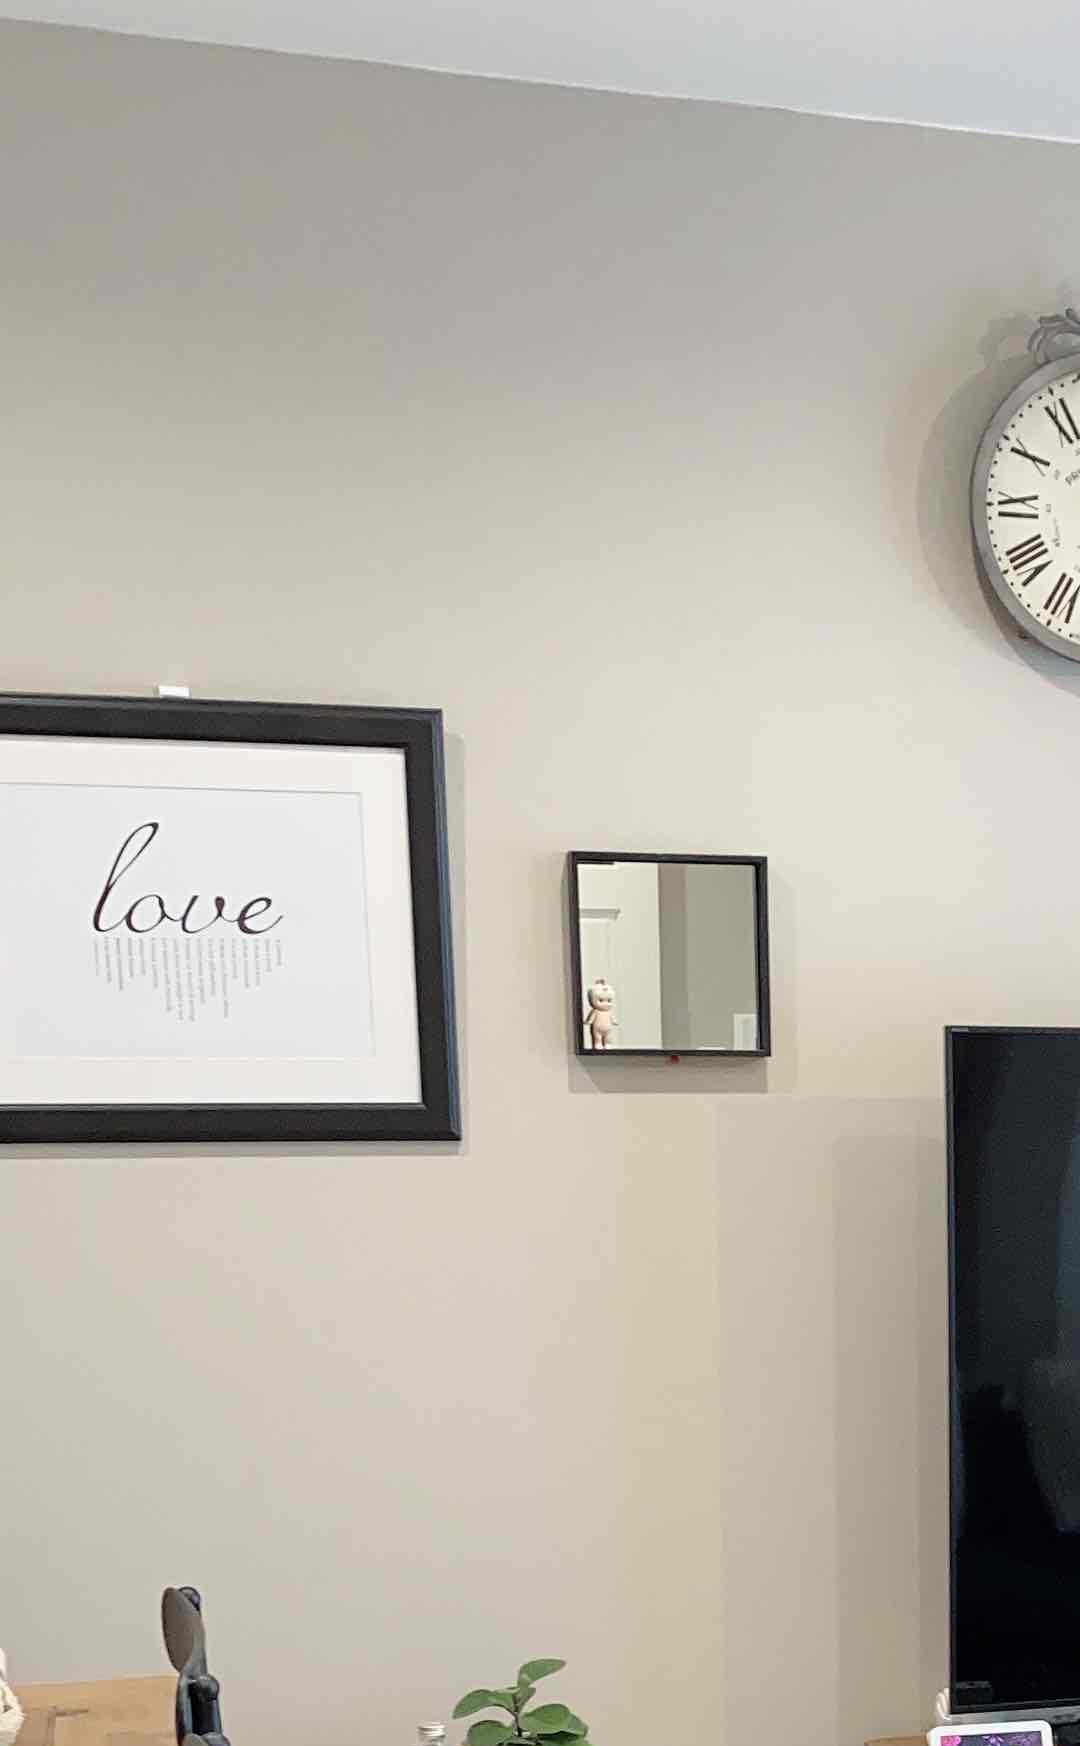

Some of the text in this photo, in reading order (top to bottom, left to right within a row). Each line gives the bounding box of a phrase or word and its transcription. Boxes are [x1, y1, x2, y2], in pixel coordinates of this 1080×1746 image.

[1044, 398, 1080, 448] XI
[1010, 438, 1050, 477] X
[998, 491, 1039, 520] IX
[1005, 534, 1053, 587] VIII
[1043, 572, 1080, 624] VII
[93, 822, 284, 934] love
